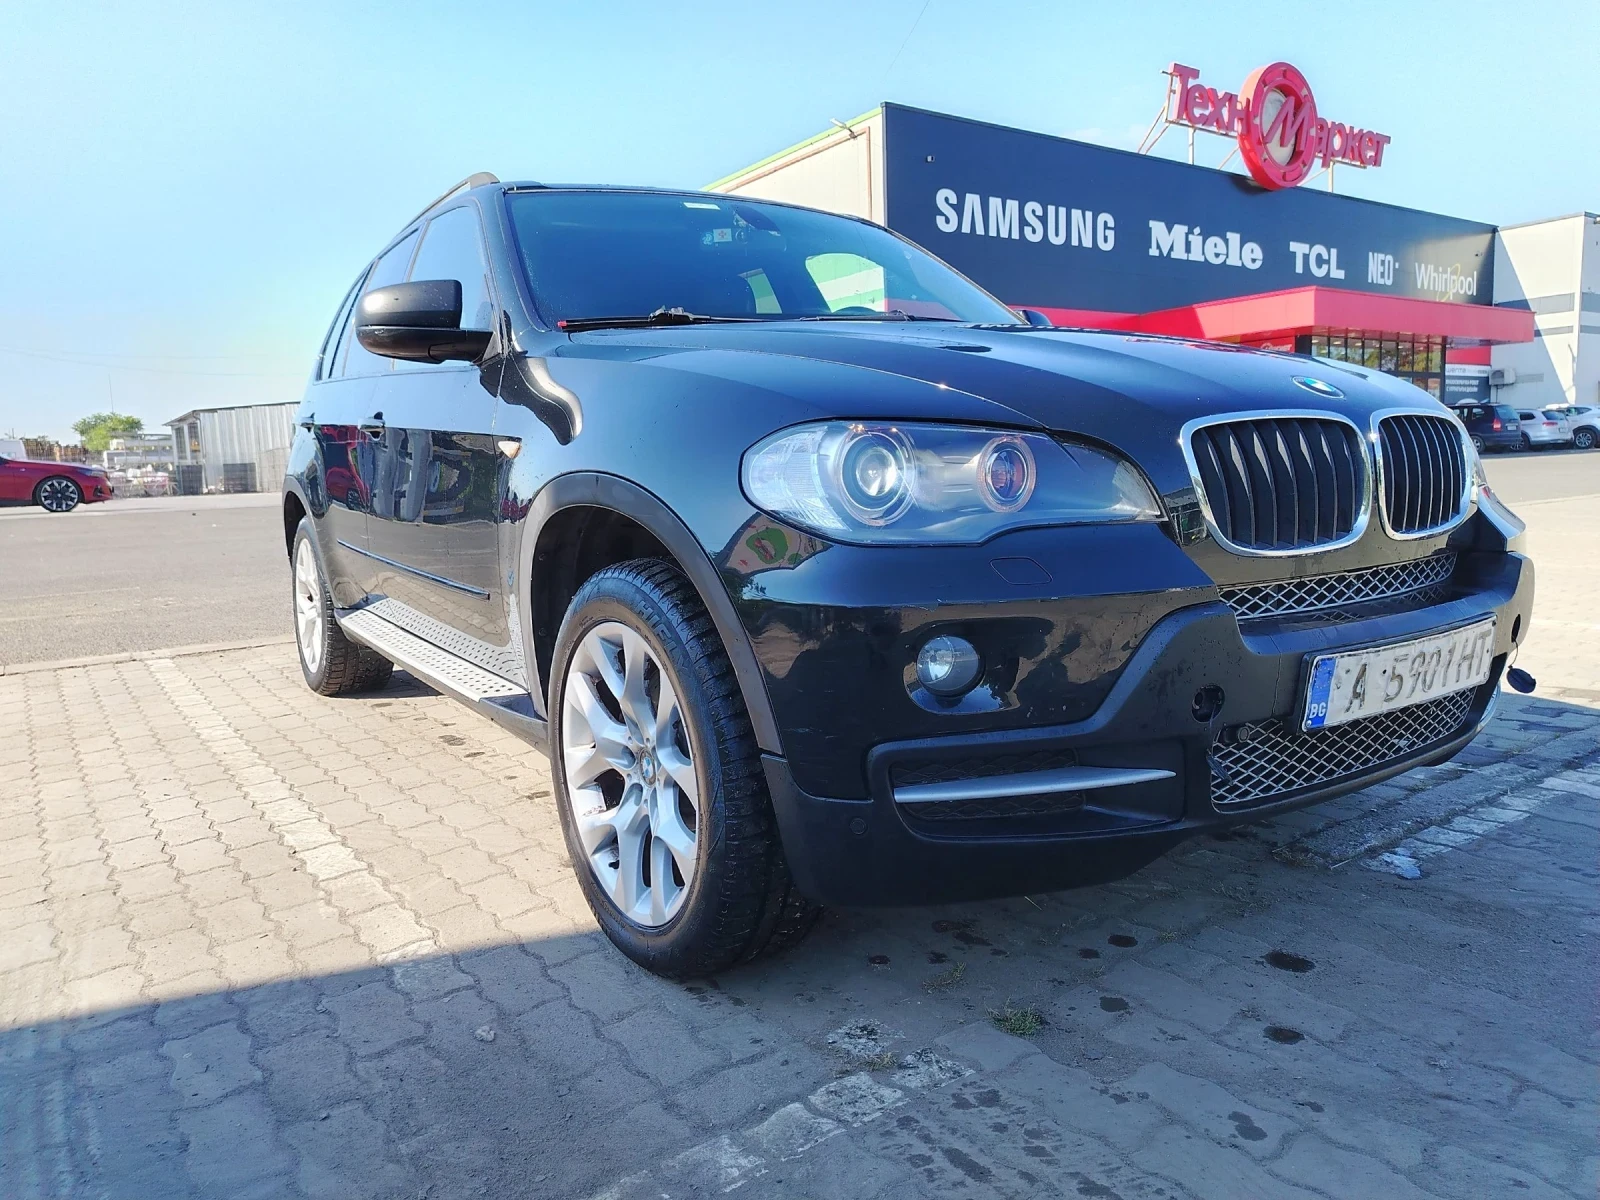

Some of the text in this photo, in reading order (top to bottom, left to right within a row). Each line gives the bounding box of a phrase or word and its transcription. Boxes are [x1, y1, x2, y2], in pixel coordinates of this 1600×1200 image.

[936, 188, 1115, 251] SAMSUNG
[1149, 220, 1263, 270] Miele
[1290, 241, 1345, 280] TCL
[1415, 262, 1477, 300] Whirlpool
[1309, 702, 1327, 718] BG
